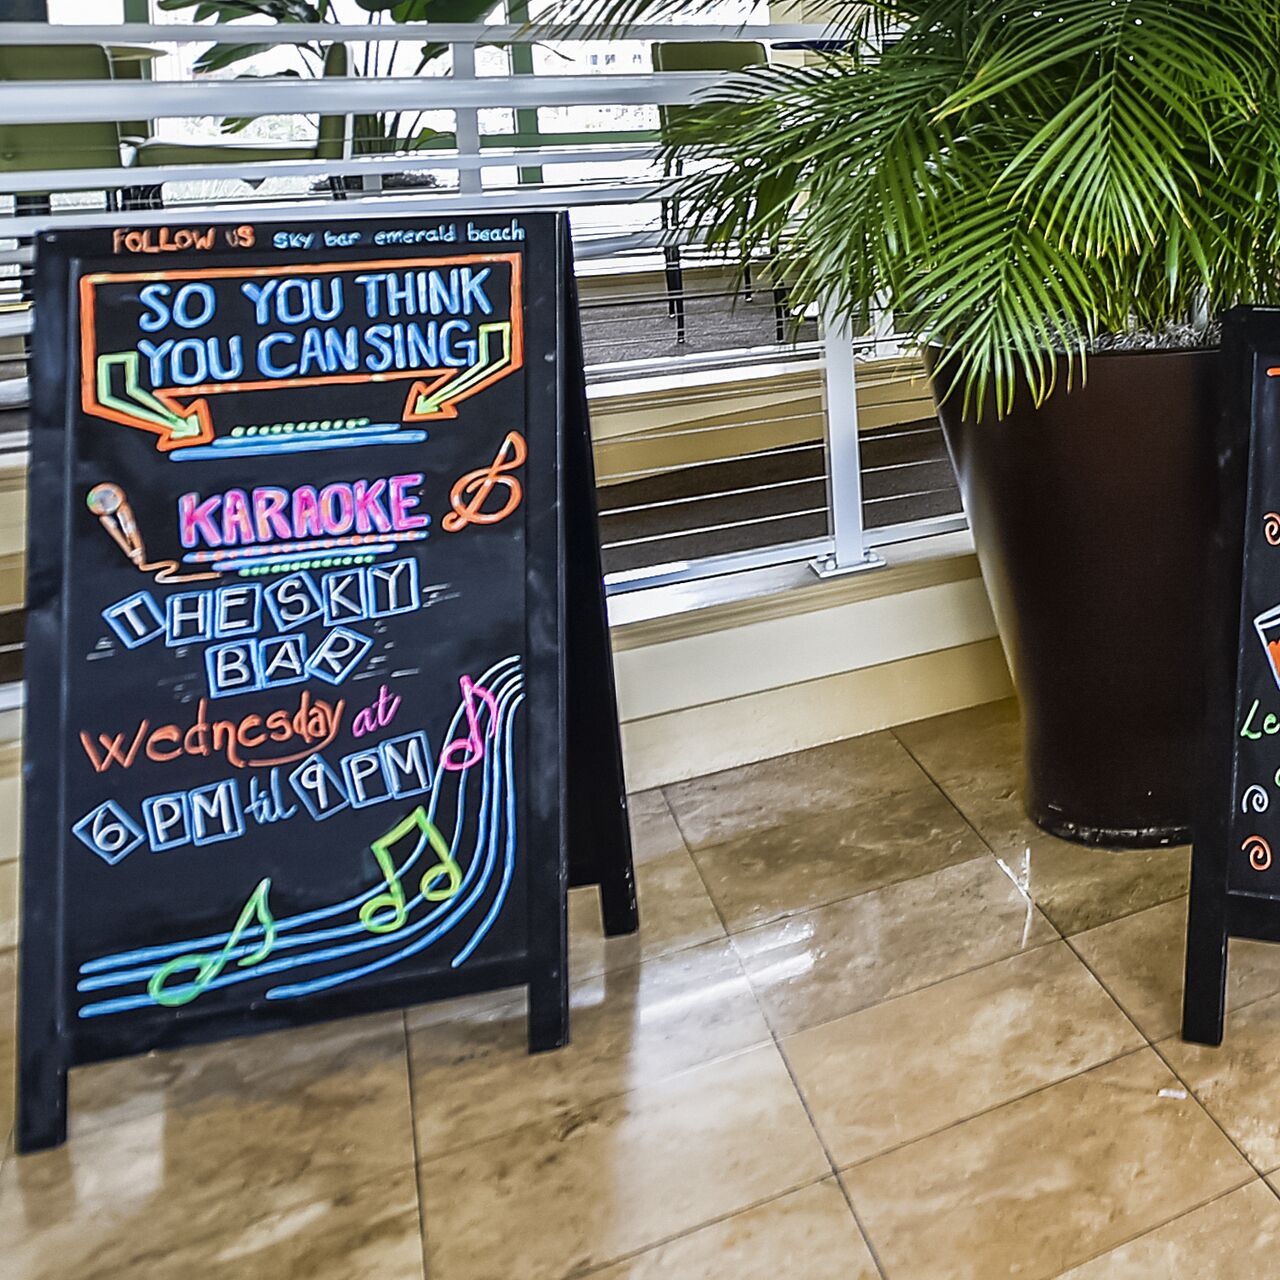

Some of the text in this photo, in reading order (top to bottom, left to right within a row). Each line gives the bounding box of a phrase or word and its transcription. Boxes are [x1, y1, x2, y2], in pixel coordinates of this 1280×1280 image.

[112, 227, 215, 254] FOLLOW
[224, 225, 256, 248] US
[324, 229, 360, 247] bar
[374, 223, 456, 246] emerald
[467, 219, 525, 243] beach
[138, 266, 493, 332] SO YOU THINK
[137, 319, 477, 387] YOU CAN SING
[177, 473, 432, 550] KARAOKE
[213, 631, 366, 692] BAR
[80, 685, 400, 773] Wednesday at
